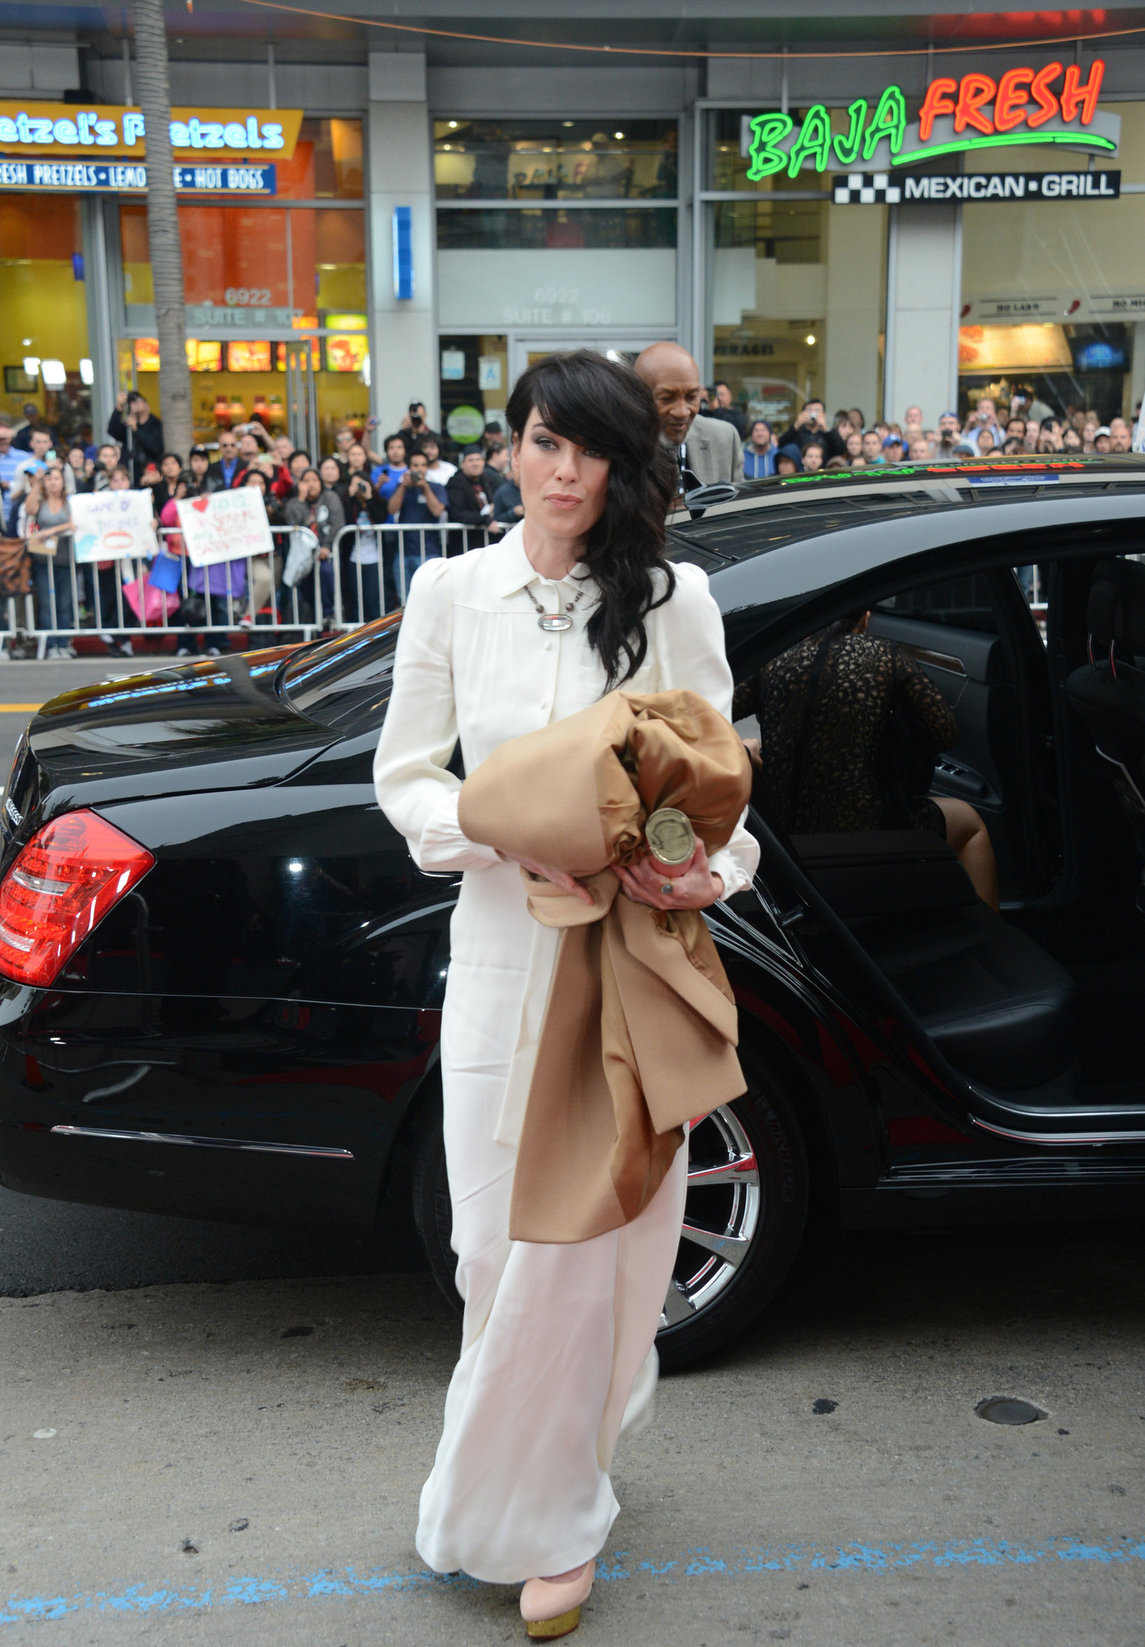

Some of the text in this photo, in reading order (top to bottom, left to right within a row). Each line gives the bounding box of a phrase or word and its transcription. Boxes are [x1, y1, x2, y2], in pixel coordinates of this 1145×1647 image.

[122, 111, 285, 149] Petzels
[745, 59, 1105, 181] BAJA FRESH
[0, 163, 265, 190] ESH PRETZELS LEMOE HOT DOGS
[904, 173, 1116, 199] MEXICAN GRILL
[225, 287, 272, 305] 6922
[533, 287, 580, 304] 6922
[194, 308, 247, 325] SUITE
[501, 308, 553, 325] SUITE
